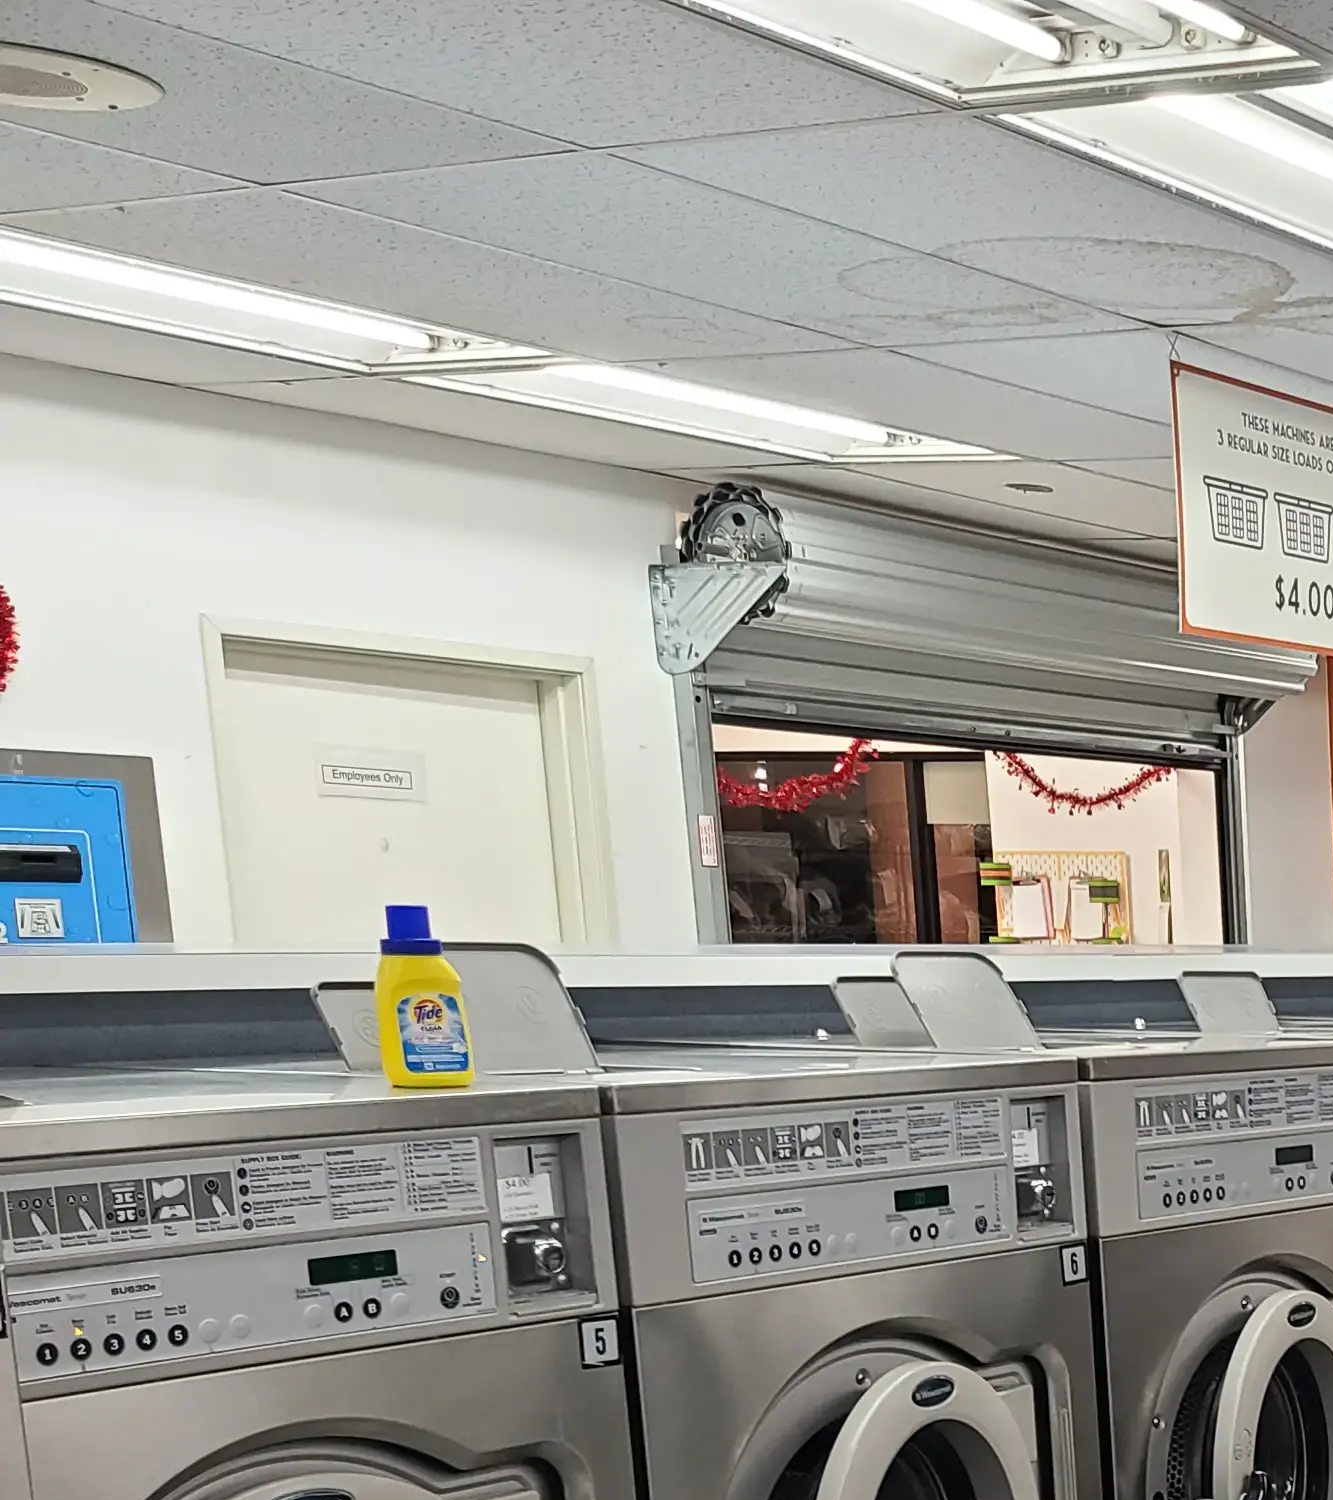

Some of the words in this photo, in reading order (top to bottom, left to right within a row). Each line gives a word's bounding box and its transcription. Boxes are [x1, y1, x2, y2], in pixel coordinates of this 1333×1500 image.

[1241, 412, 1269, 434] THESE
[1272, 421, 1316, 446] MACHINES
[1217, 429, 1224, 446] 3
[1227, 432, 1269, 458] REGULAR
[1271, 445, 1290, 464] SIZE
[1293, 450, 1323, 472] LOADS
[332, 768, 381, 784] Employees
[383, 772, 403, 786] Only
[413, 1004, 443, 1025] Tide
[1070, 1252, 1079, 1275] 6
[594, 1327, 607, 1356] 5
